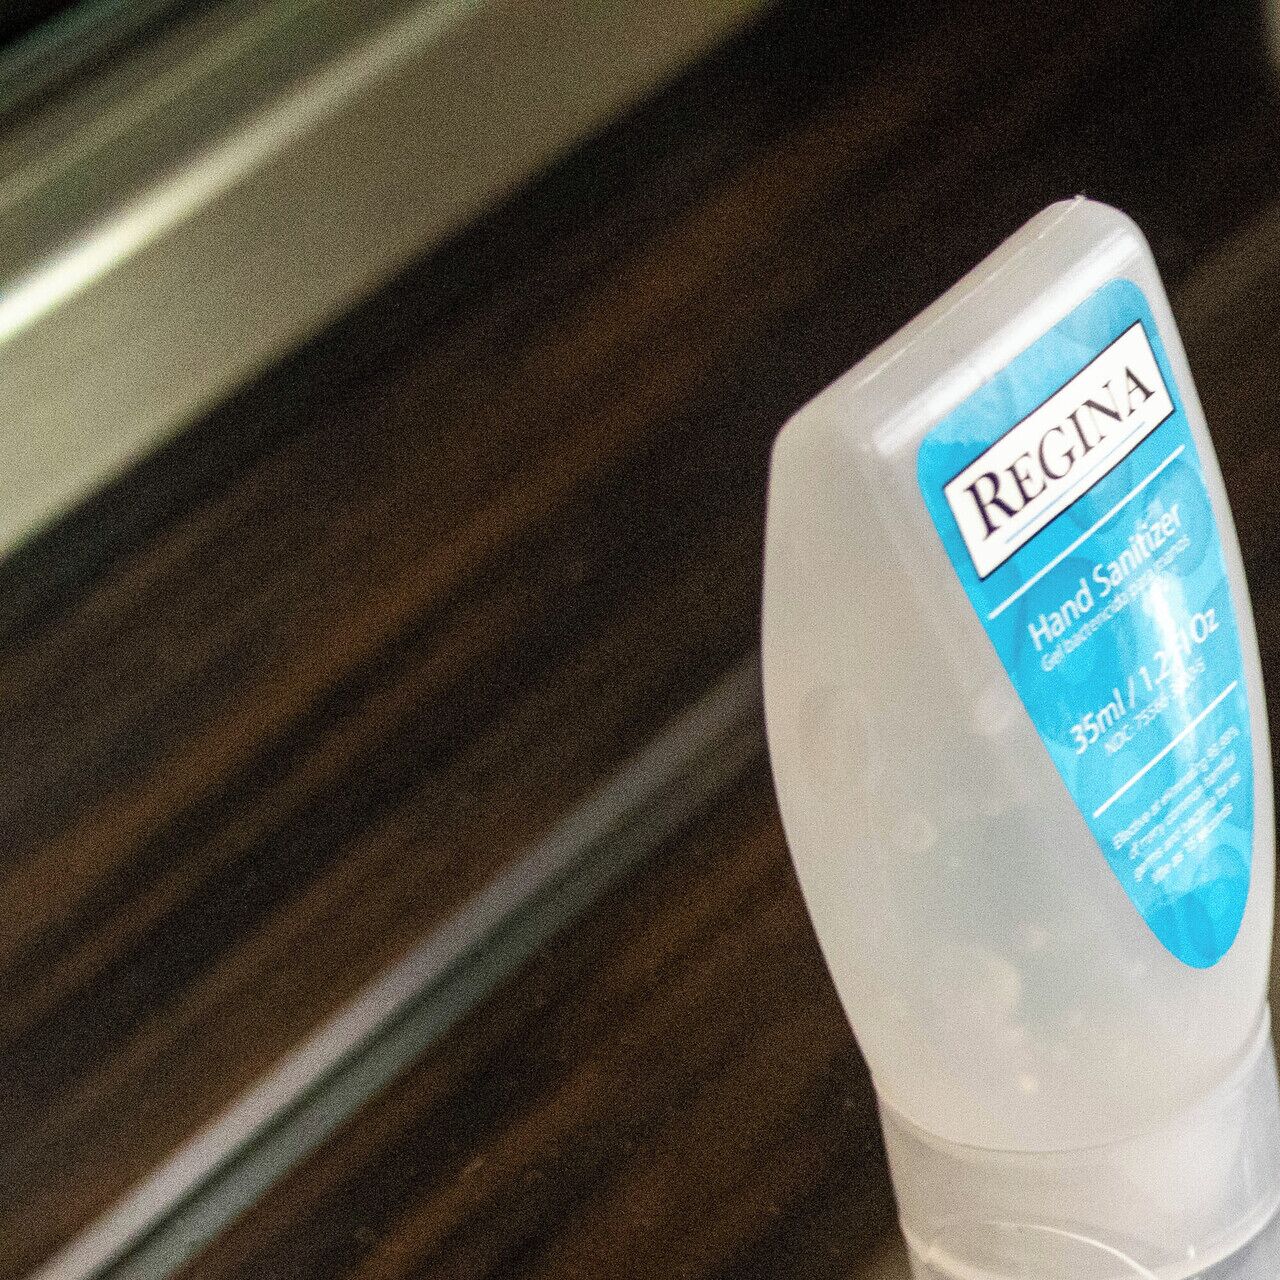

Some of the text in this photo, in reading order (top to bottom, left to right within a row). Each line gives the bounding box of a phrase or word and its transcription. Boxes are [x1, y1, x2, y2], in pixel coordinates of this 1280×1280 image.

[962, 365, 1156, 541] REGINA
[1027, 504, 1182, 652] Hand Sanitizer
[1068, 687, 1127, 756] 35ml
[1189, 607, 1220, 645] Oz
